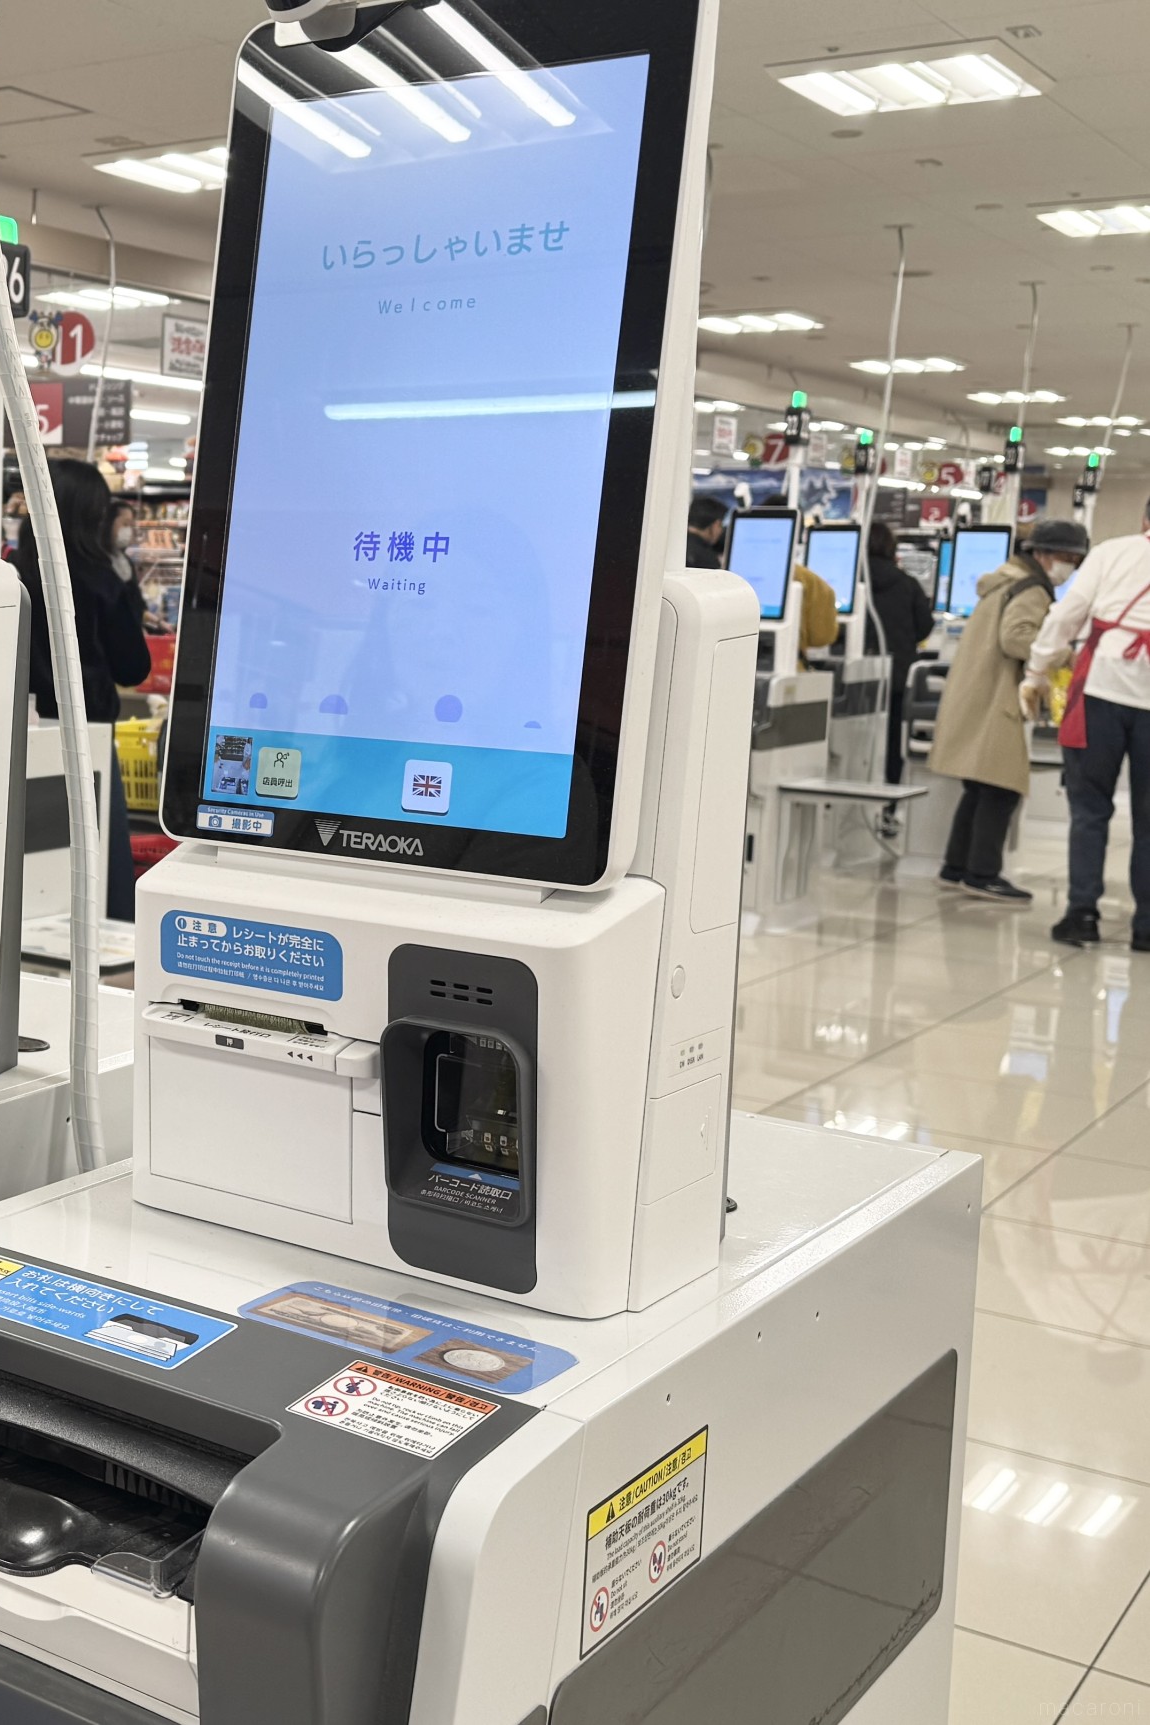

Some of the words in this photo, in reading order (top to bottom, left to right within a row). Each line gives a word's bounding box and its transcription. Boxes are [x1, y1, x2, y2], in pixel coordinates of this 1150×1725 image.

[322, 219, 570, 271] いらっしゃいませ
[378, 295, 477, 315] Welcome
[941, 467, 956, 484] 5
[353, 531, 451, 563] 待機中
[368, 577, 427, 595] Waiting
[262, 776, 293, 788] 店員呼出
[231, 817, 262, 831] 撮影中
[339, 830, 424, 857] TERAOKA
[192, 919, 217, 934] 注意
[232, 925, 324, 953] レシートが完全に
[177, 932, 324, 969] 止まってからお取りください
[184, 952, 194, 961] not
[210, 956, 220, 965] the
[220, 958, 240, 970] receipt
[270, 966, 301, 980] completely
[302, 971, 324, 984] printed
[428, 1174, 512, 1199] バーコード読取口
[433, 1185, 464, 1196] BARCODE
[464, 1192, 496, 1204] SCANNER
[4, 1277, 113, 1313] 入れてください
[21, 1270, 163, 1315] お札は横向きにして
